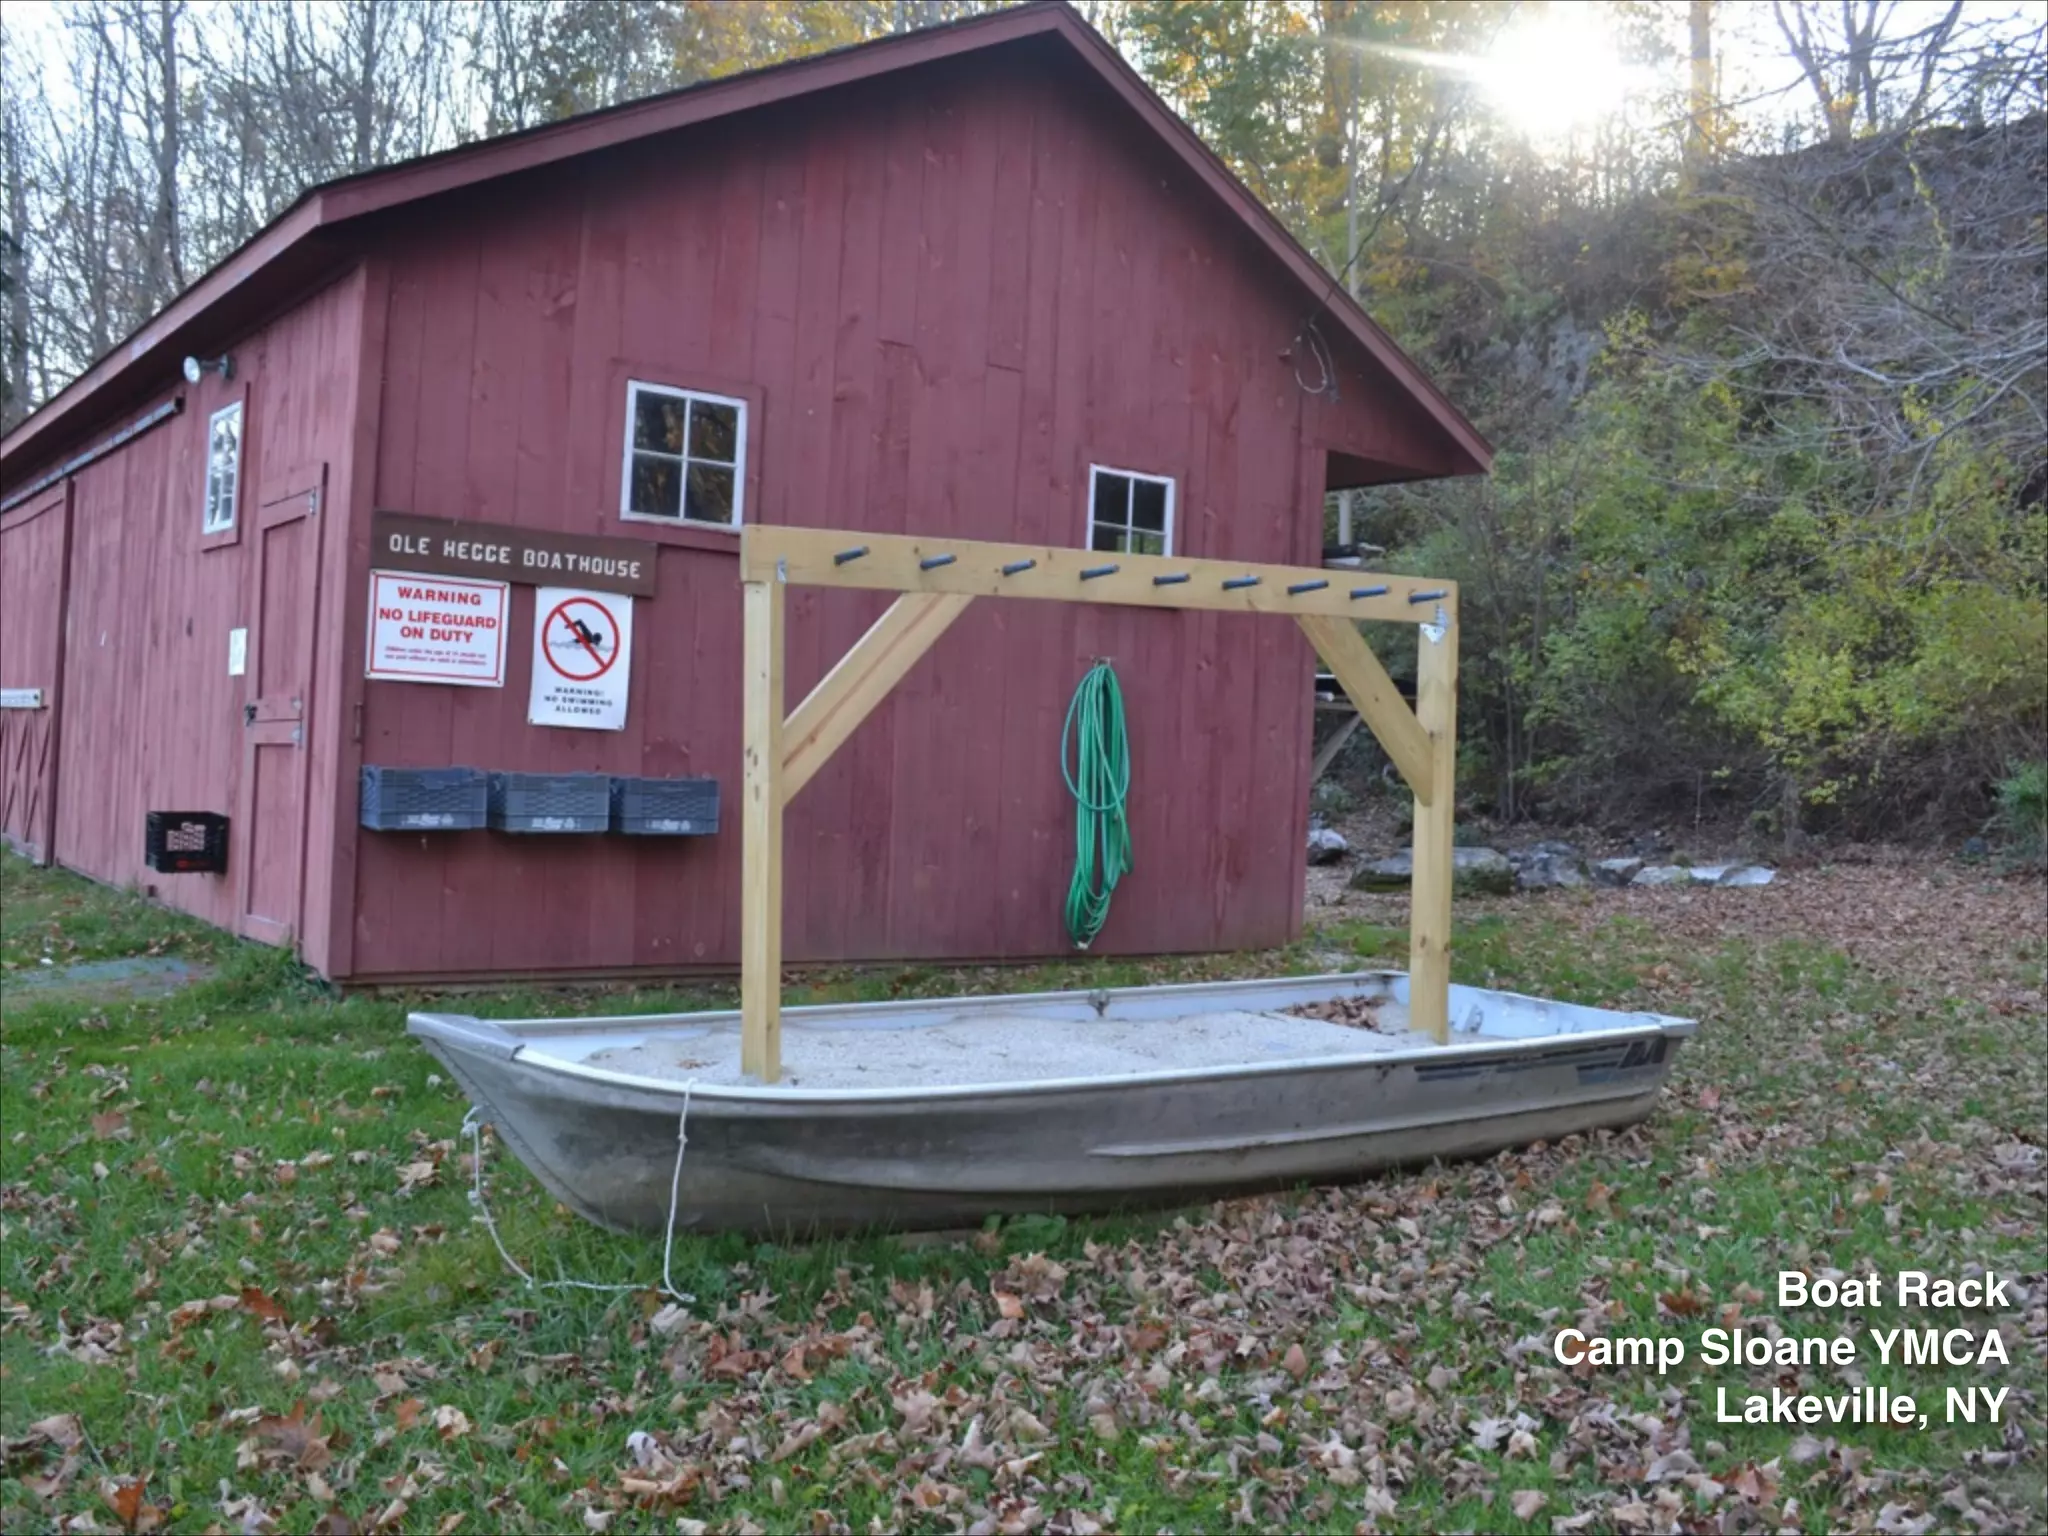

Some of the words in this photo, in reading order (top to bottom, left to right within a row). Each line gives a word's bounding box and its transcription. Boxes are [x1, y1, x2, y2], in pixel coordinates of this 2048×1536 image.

[389, 534, 430, 555] OLE
[523, 549, 641, 579] BOATHOUSE
[397, 586, 482, 606] WARNING
[379, 608, 403, 621] NO
[408, 610, 496, 629] LIFEGUARD
[400, 626, 424, 640] ON
[430, 628, 474, 643] DUTY
[555, 705, 602, 715] ALLOWED
[562, 696, 613, 707] SWIMMING
